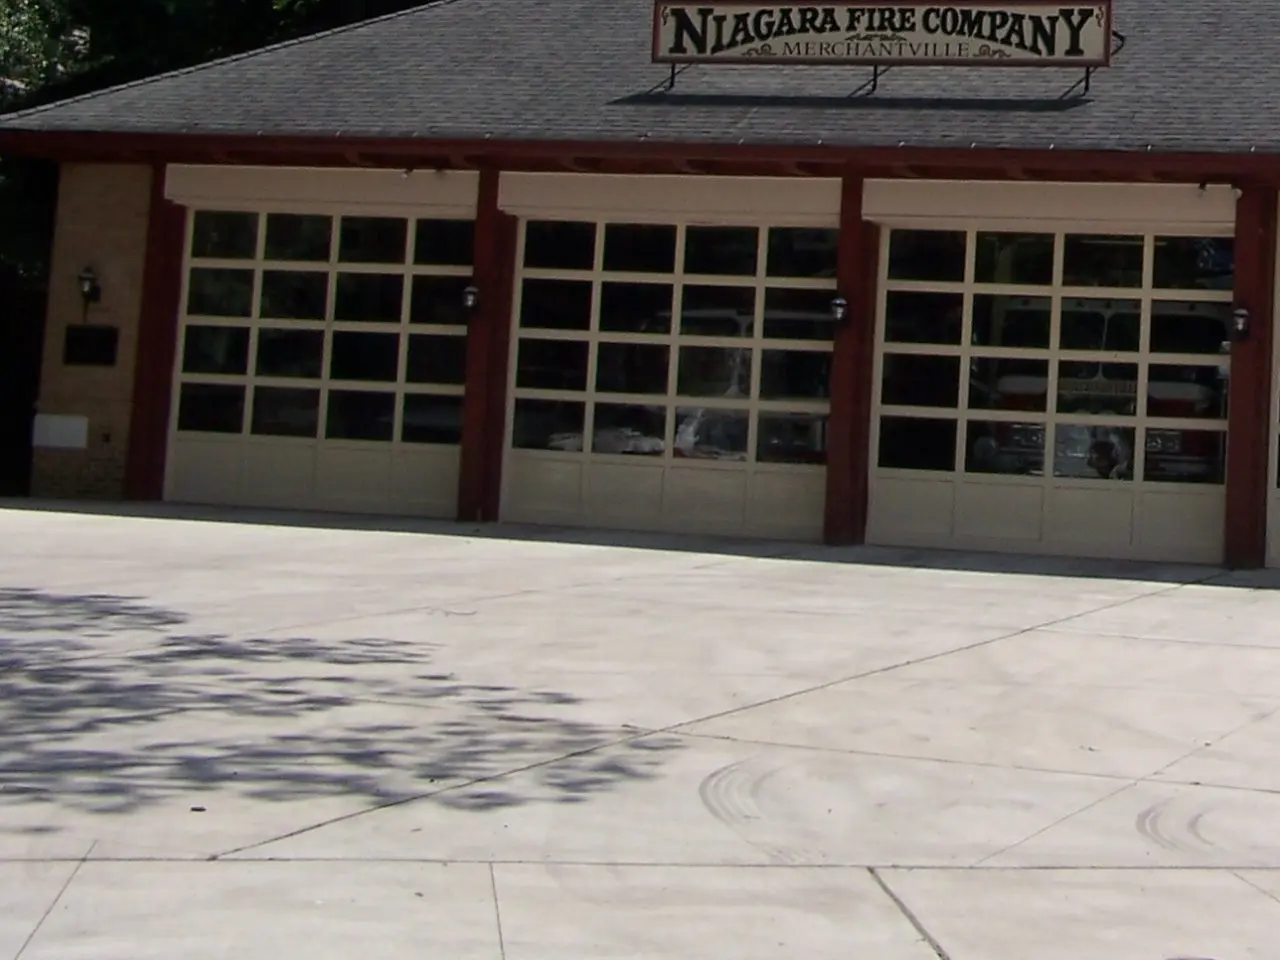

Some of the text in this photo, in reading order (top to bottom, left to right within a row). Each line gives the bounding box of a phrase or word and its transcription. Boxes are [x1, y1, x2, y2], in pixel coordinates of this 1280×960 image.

[668, 6, 1095, 57] NIAGARA FIRE COMPANY
[781, 41, 970, 58] MERCHANTVILLE
